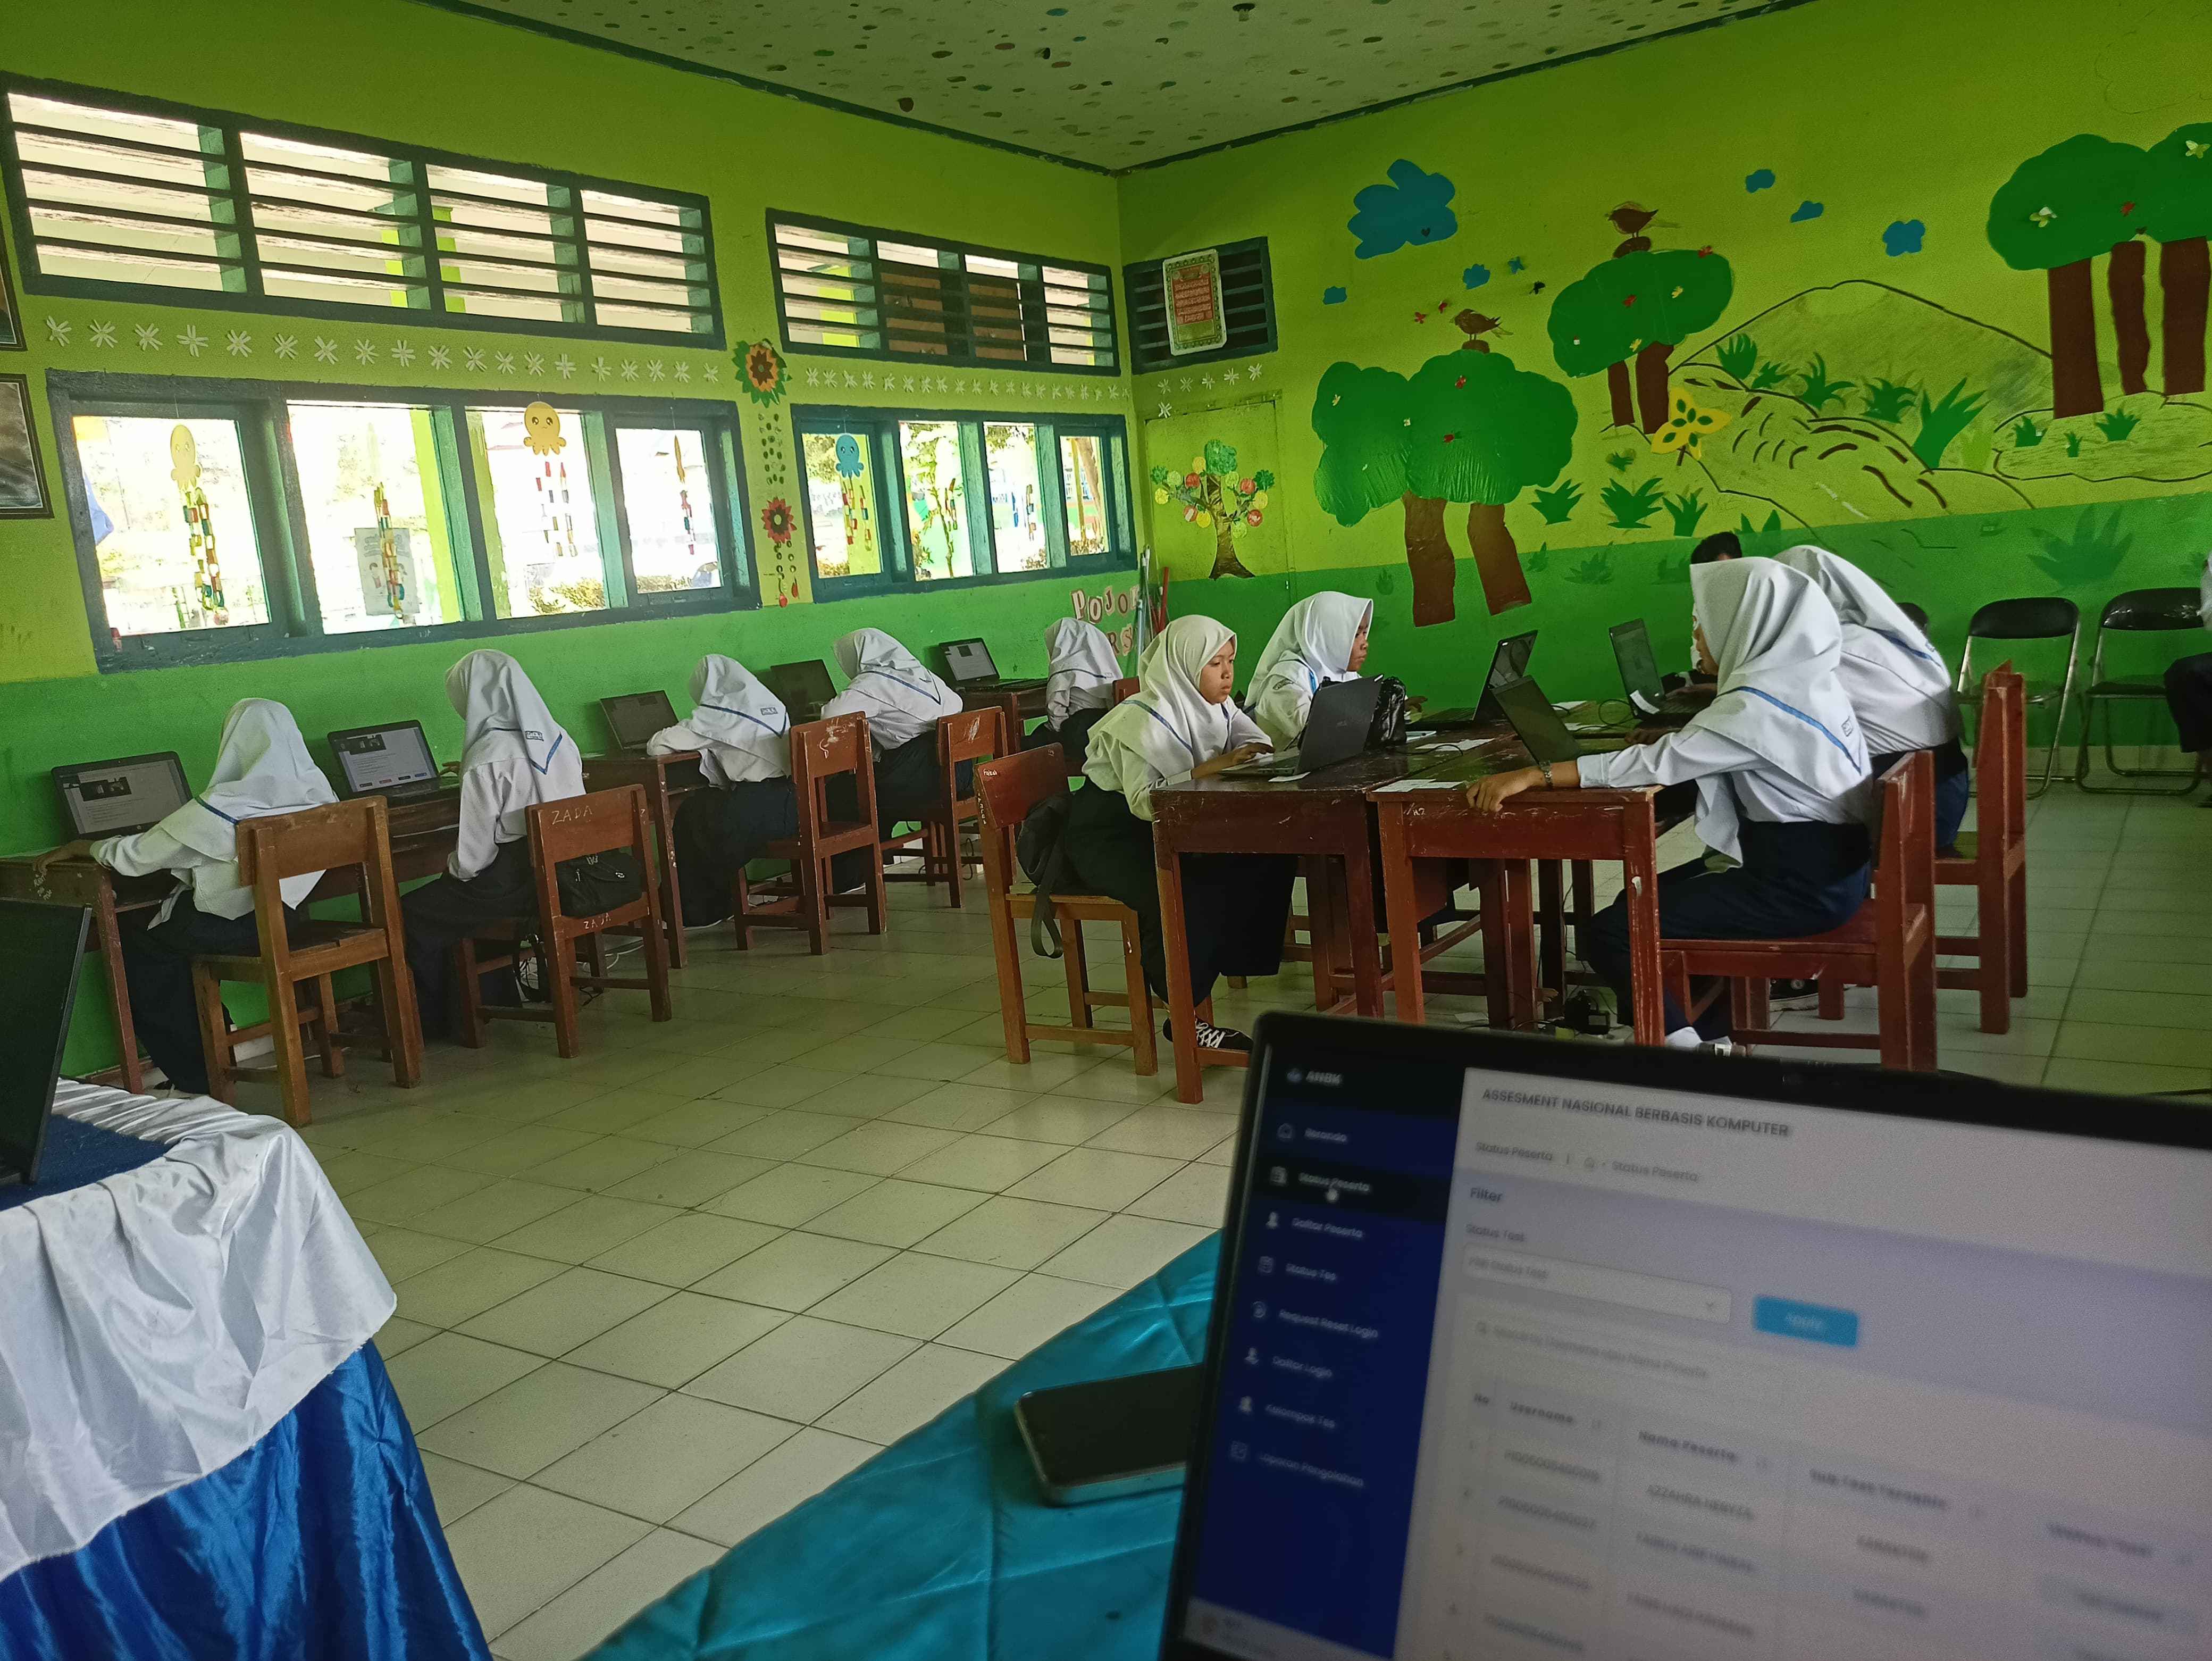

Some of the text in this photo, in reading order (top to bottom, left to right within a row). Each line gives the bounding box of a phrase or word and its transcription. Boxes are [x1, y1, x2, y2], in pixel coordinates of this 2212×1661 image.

[551, 805, 593, 825] ZADA
[1482, 1089, 1790, 1137] ASSESMENT NASIONAL BERBASIS KOMPUTER
[1476, 1142, 1553, 1162] Status Peserta
[1612, 1160, 1698, 1182] Status Peserta
[1470, 1187, 1504, 1203] Filter
[1510, 1401, 1573, 1424] Username
